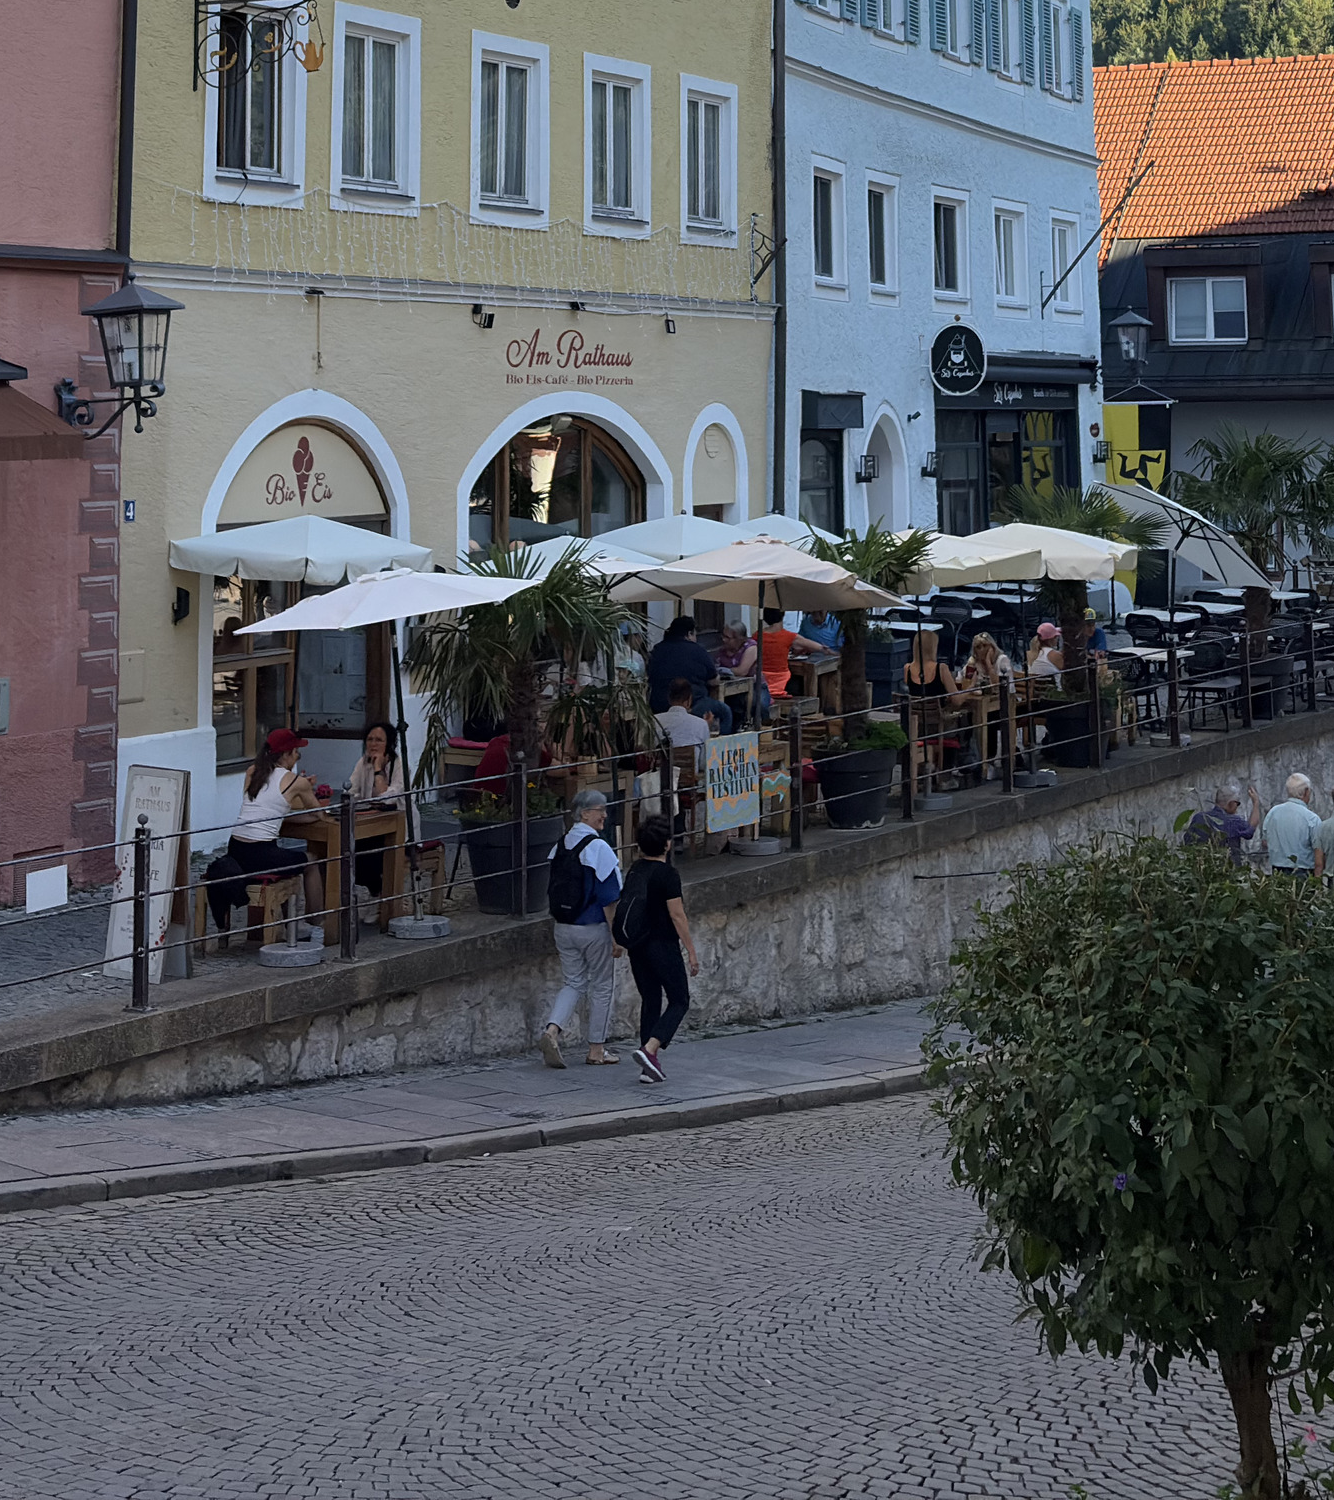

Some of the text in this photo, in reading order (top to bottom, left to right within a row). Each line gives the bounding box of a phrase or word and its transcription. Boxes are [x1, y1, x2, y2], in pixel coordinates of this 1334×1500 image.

[506, 328, 634, 369] Am Rathaus
[506, 373, 523, 385] Bio
[526, 373, 568, 385] Eis-Café
[576, 374, 594, 386] Bio
[595, 375, 634, 386] Pizzeria
[266, 472, 333, 505] Bio Eis
[126, 502, 134, 520] 4
[721, 748, 745, 767] LECH
[709, 761, 757, 784] RAUSCHEN
[712, 777, 755, 799] FESTIVAL
